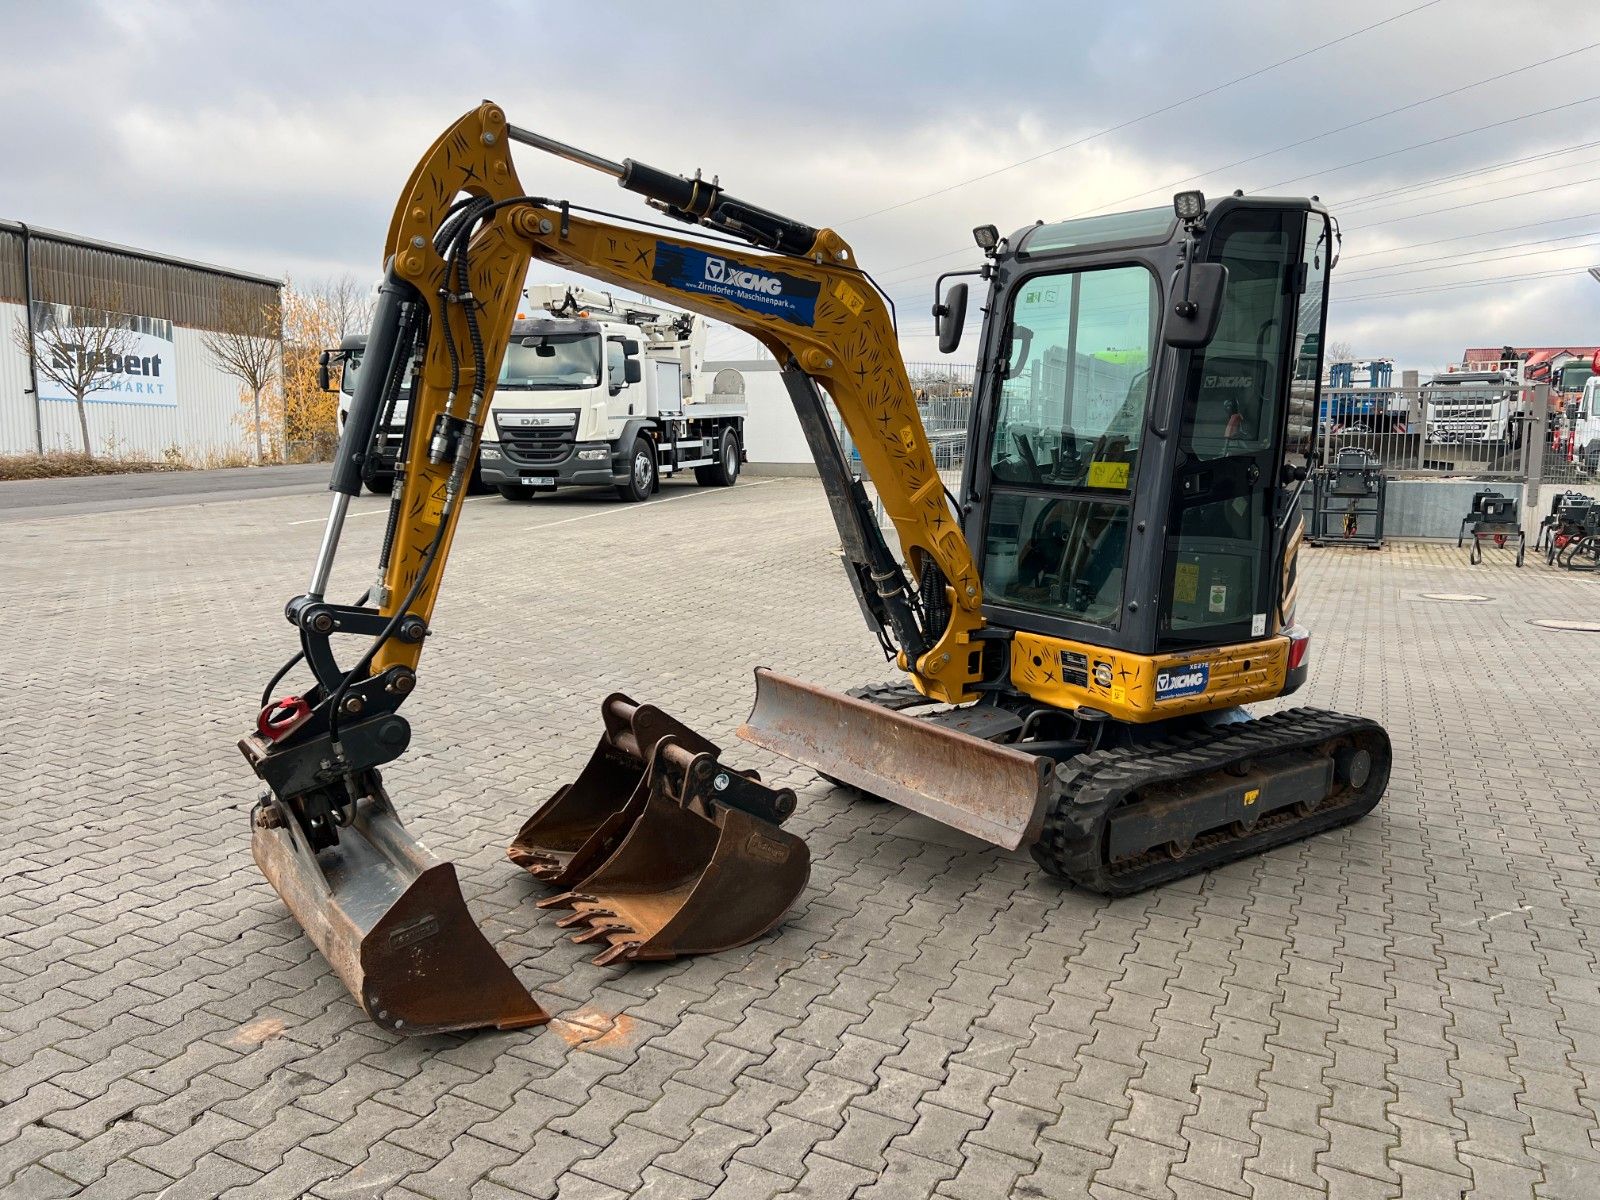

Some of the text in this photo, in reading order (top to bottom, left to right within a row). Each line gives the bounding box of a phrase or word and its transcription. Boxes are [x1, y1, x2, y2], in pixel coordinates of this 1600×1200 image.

[723, 267, 782, 295] XCMG
[520, 418, 550, 426] DAF
[1168, 672, 1204, 690] XCMG
